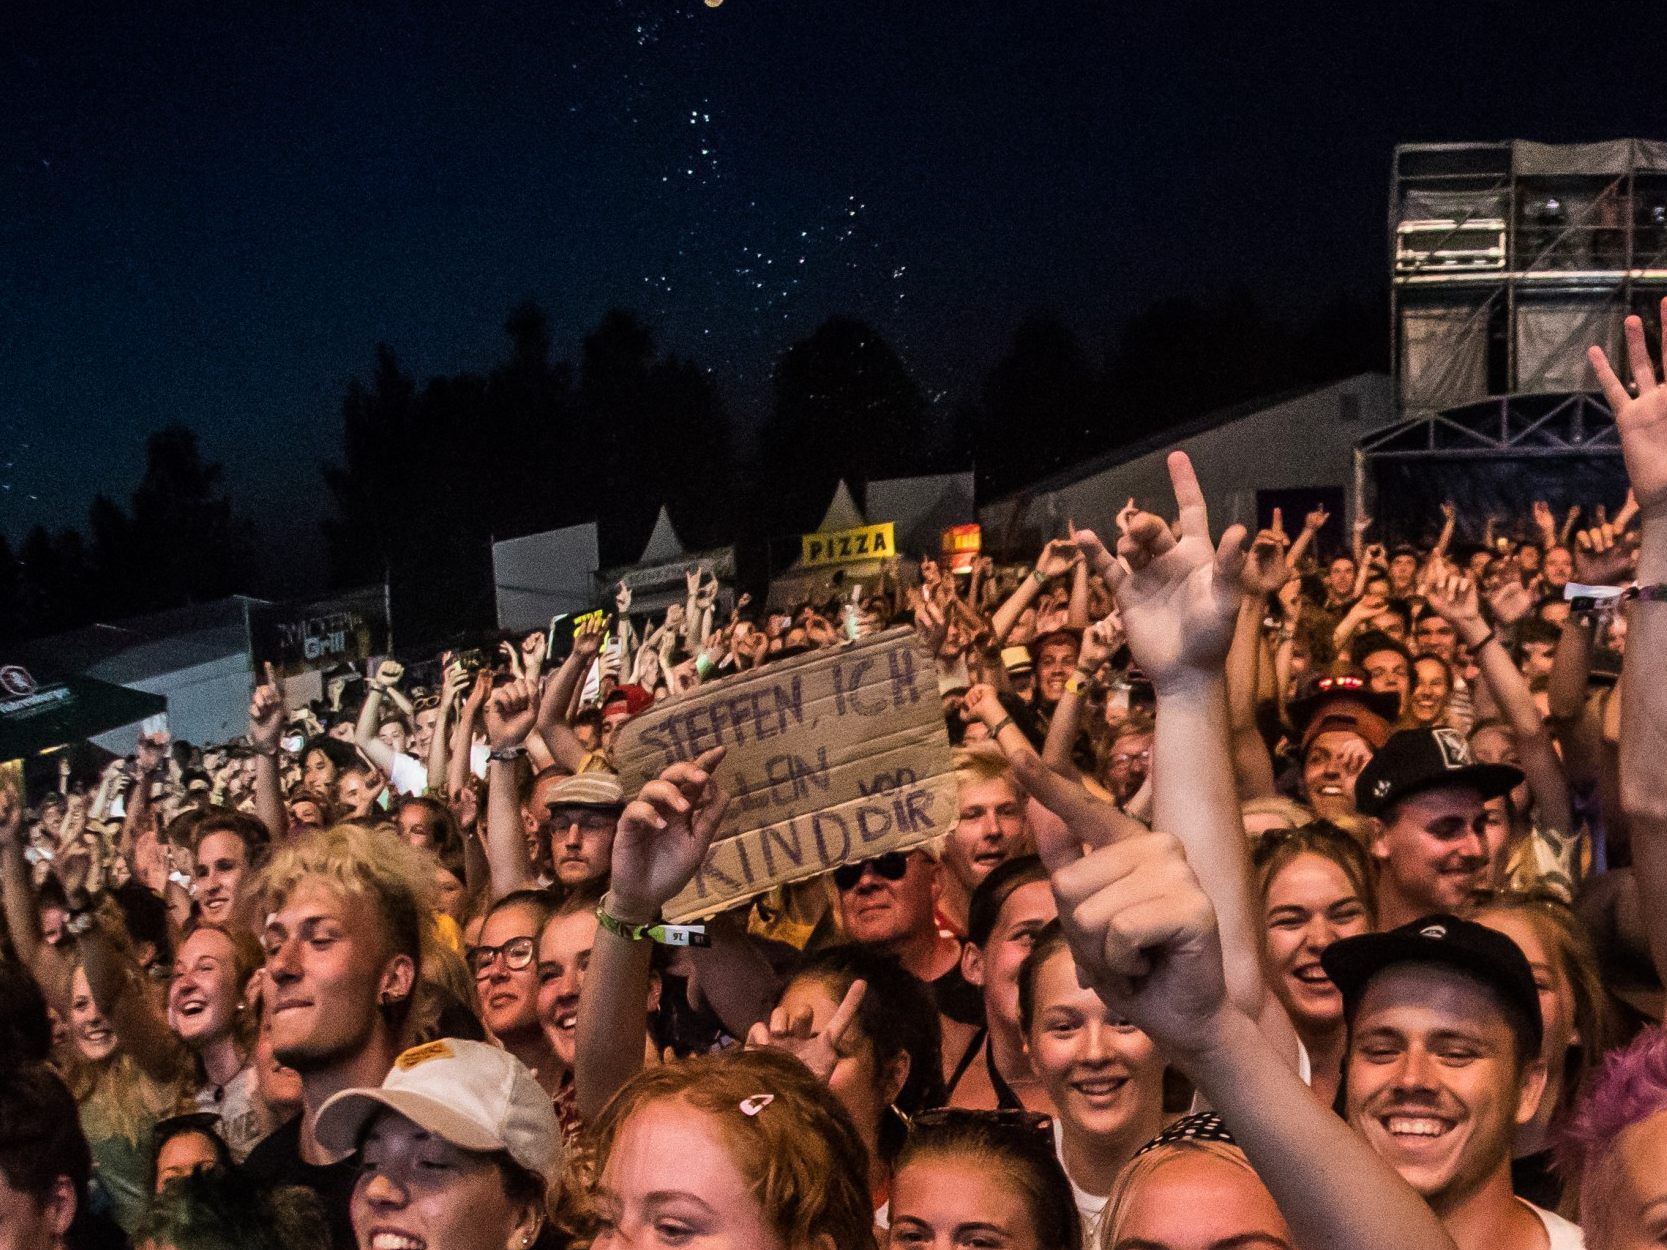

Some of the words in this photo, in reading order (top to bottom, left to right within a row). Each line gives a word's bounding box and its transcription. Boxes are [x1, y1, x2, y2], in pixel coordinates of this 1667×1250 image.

[809, 532, 887, 561] PIZZA
[832, 650, 920, 716] ICH
[698, 807, 850, 897] KIND
[857, 789, 935, 842] DIR
